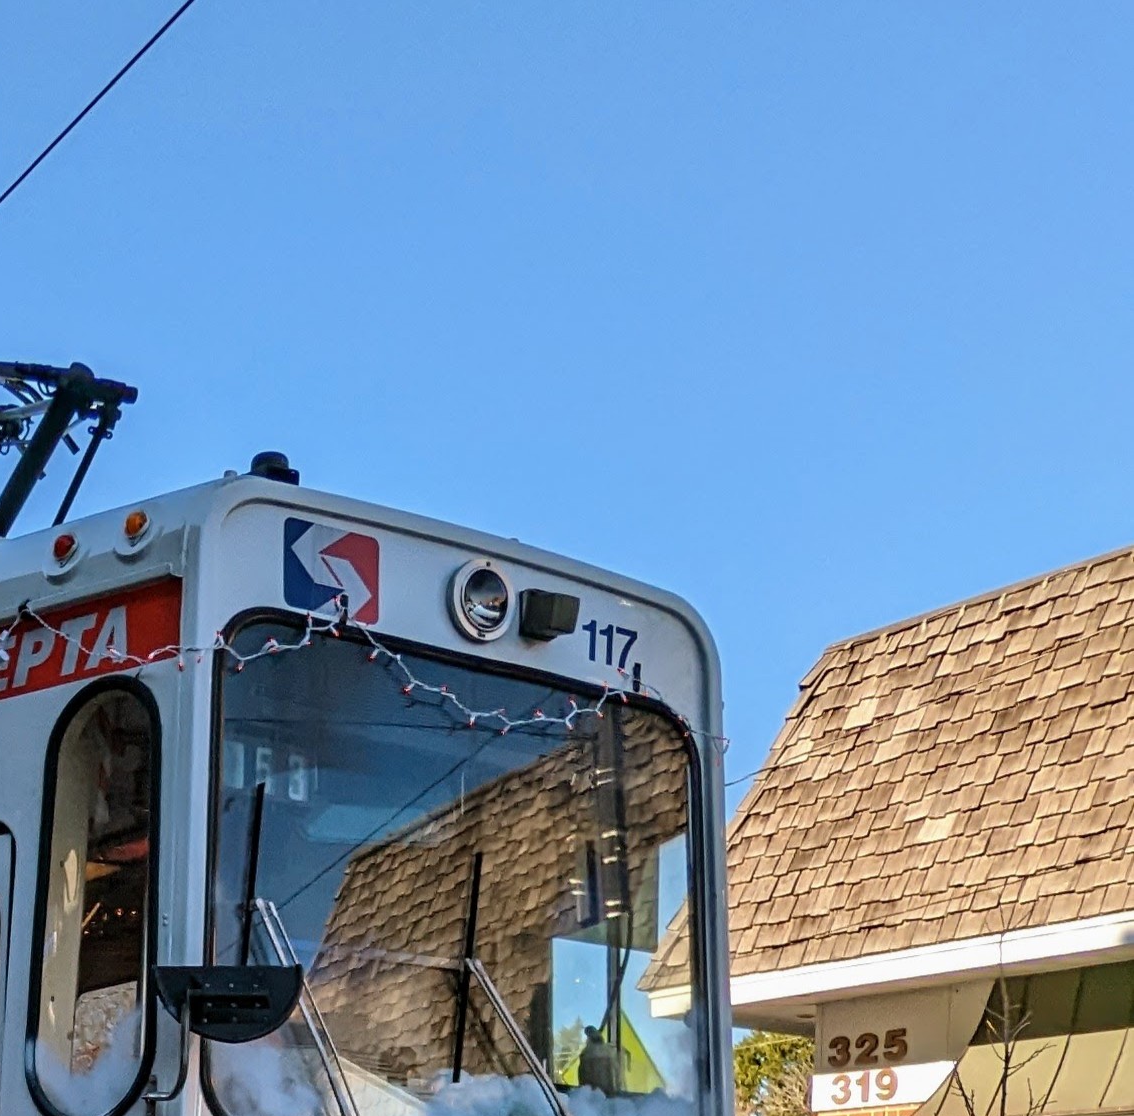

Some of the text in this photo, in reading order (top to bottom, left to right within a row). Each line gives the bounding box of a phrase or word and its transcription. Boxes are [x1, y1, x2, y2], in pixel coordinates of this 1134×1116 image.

[582, 619, 638, 669] 117
[828, 1028, 908, 1067] 325
[831, 1067, 898, 1105] 319
